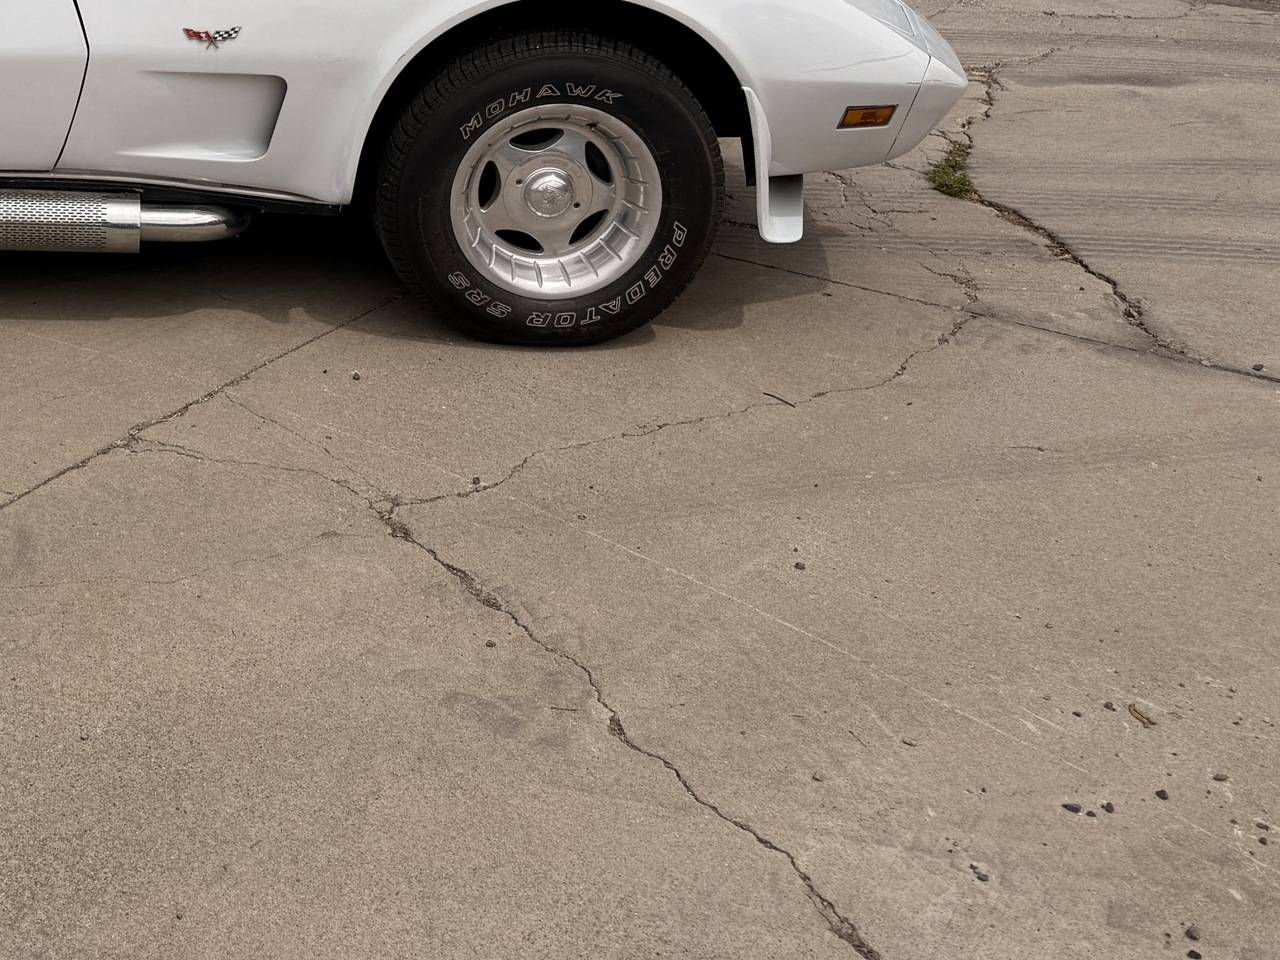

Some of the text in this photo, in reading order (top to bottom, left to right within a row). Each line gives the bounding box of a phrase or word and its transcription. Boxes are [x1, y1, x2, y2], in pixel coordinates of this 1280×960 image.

[459, 82, 624, 140] MOHAWK
[448, 221, 688, 328] PREDATOR SRS
